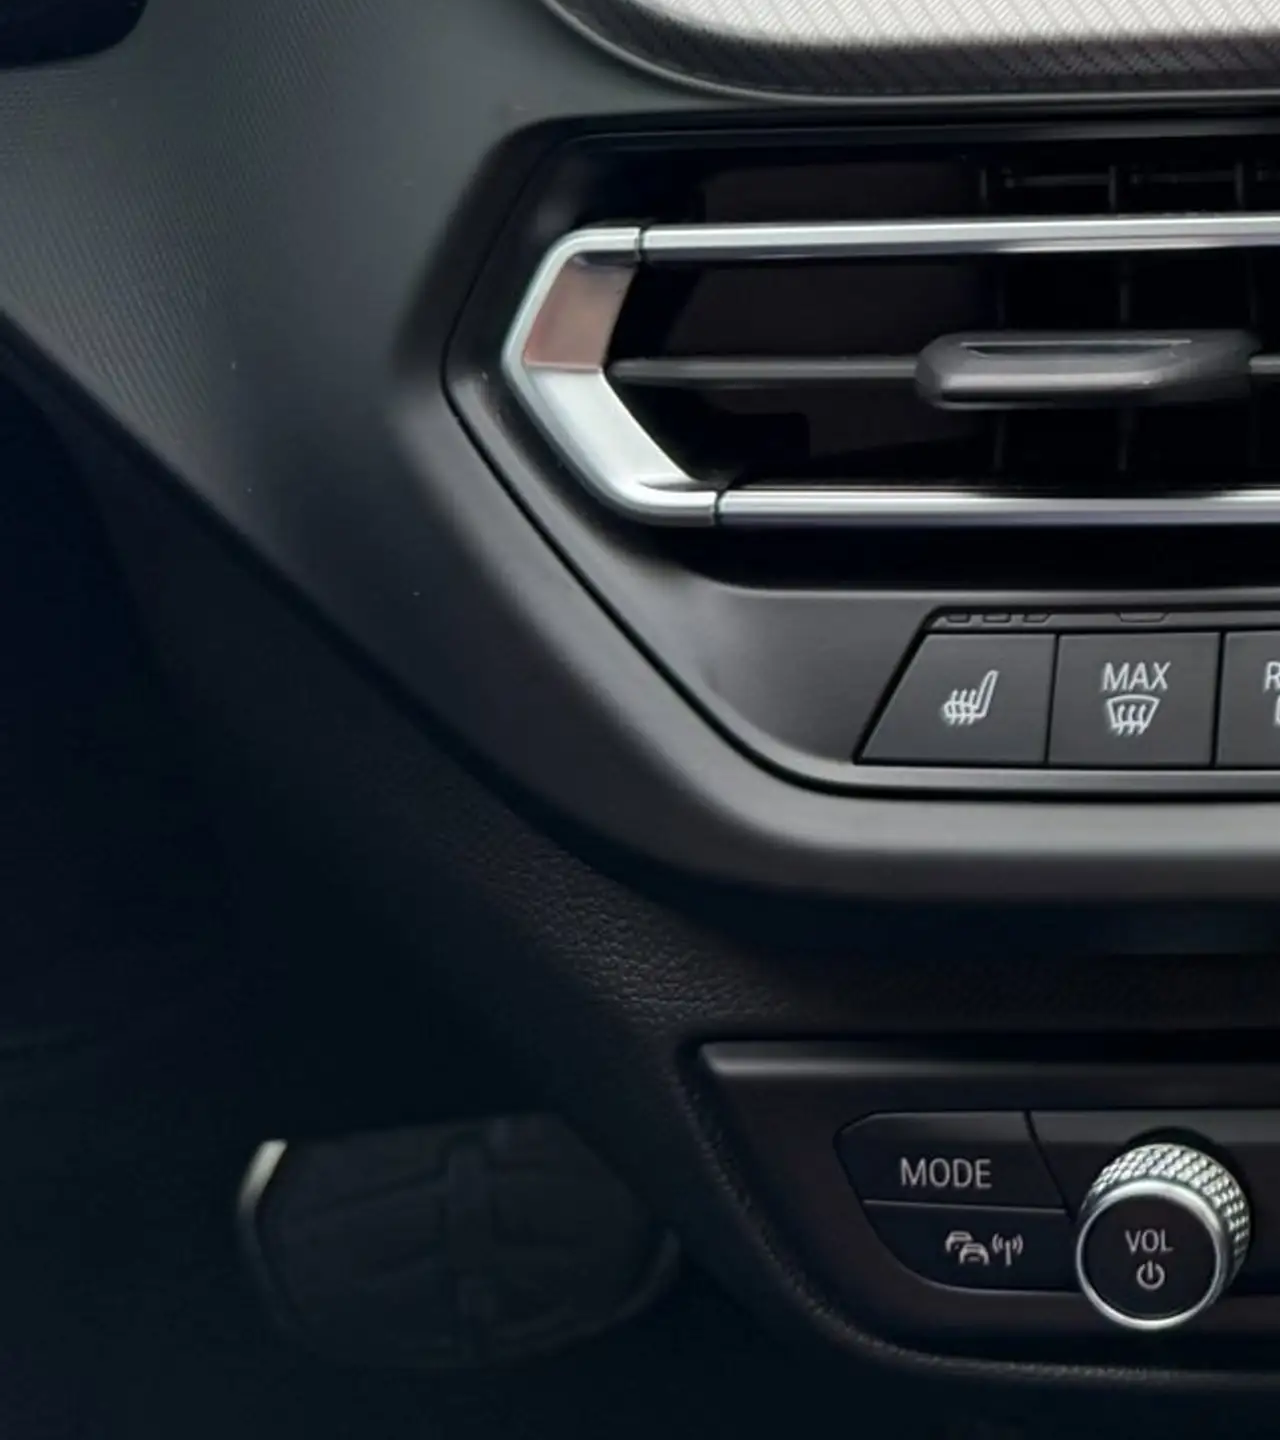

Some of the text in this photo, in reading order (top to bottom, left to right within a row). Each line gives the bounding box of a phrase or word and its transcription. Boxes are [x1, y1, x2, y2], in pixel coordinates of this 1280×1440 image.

[1101, 661, 1170, 691] MAX
[901, 1158, 992, 1189] MODE
[1126, 1229, 1173, 1253] VOL
